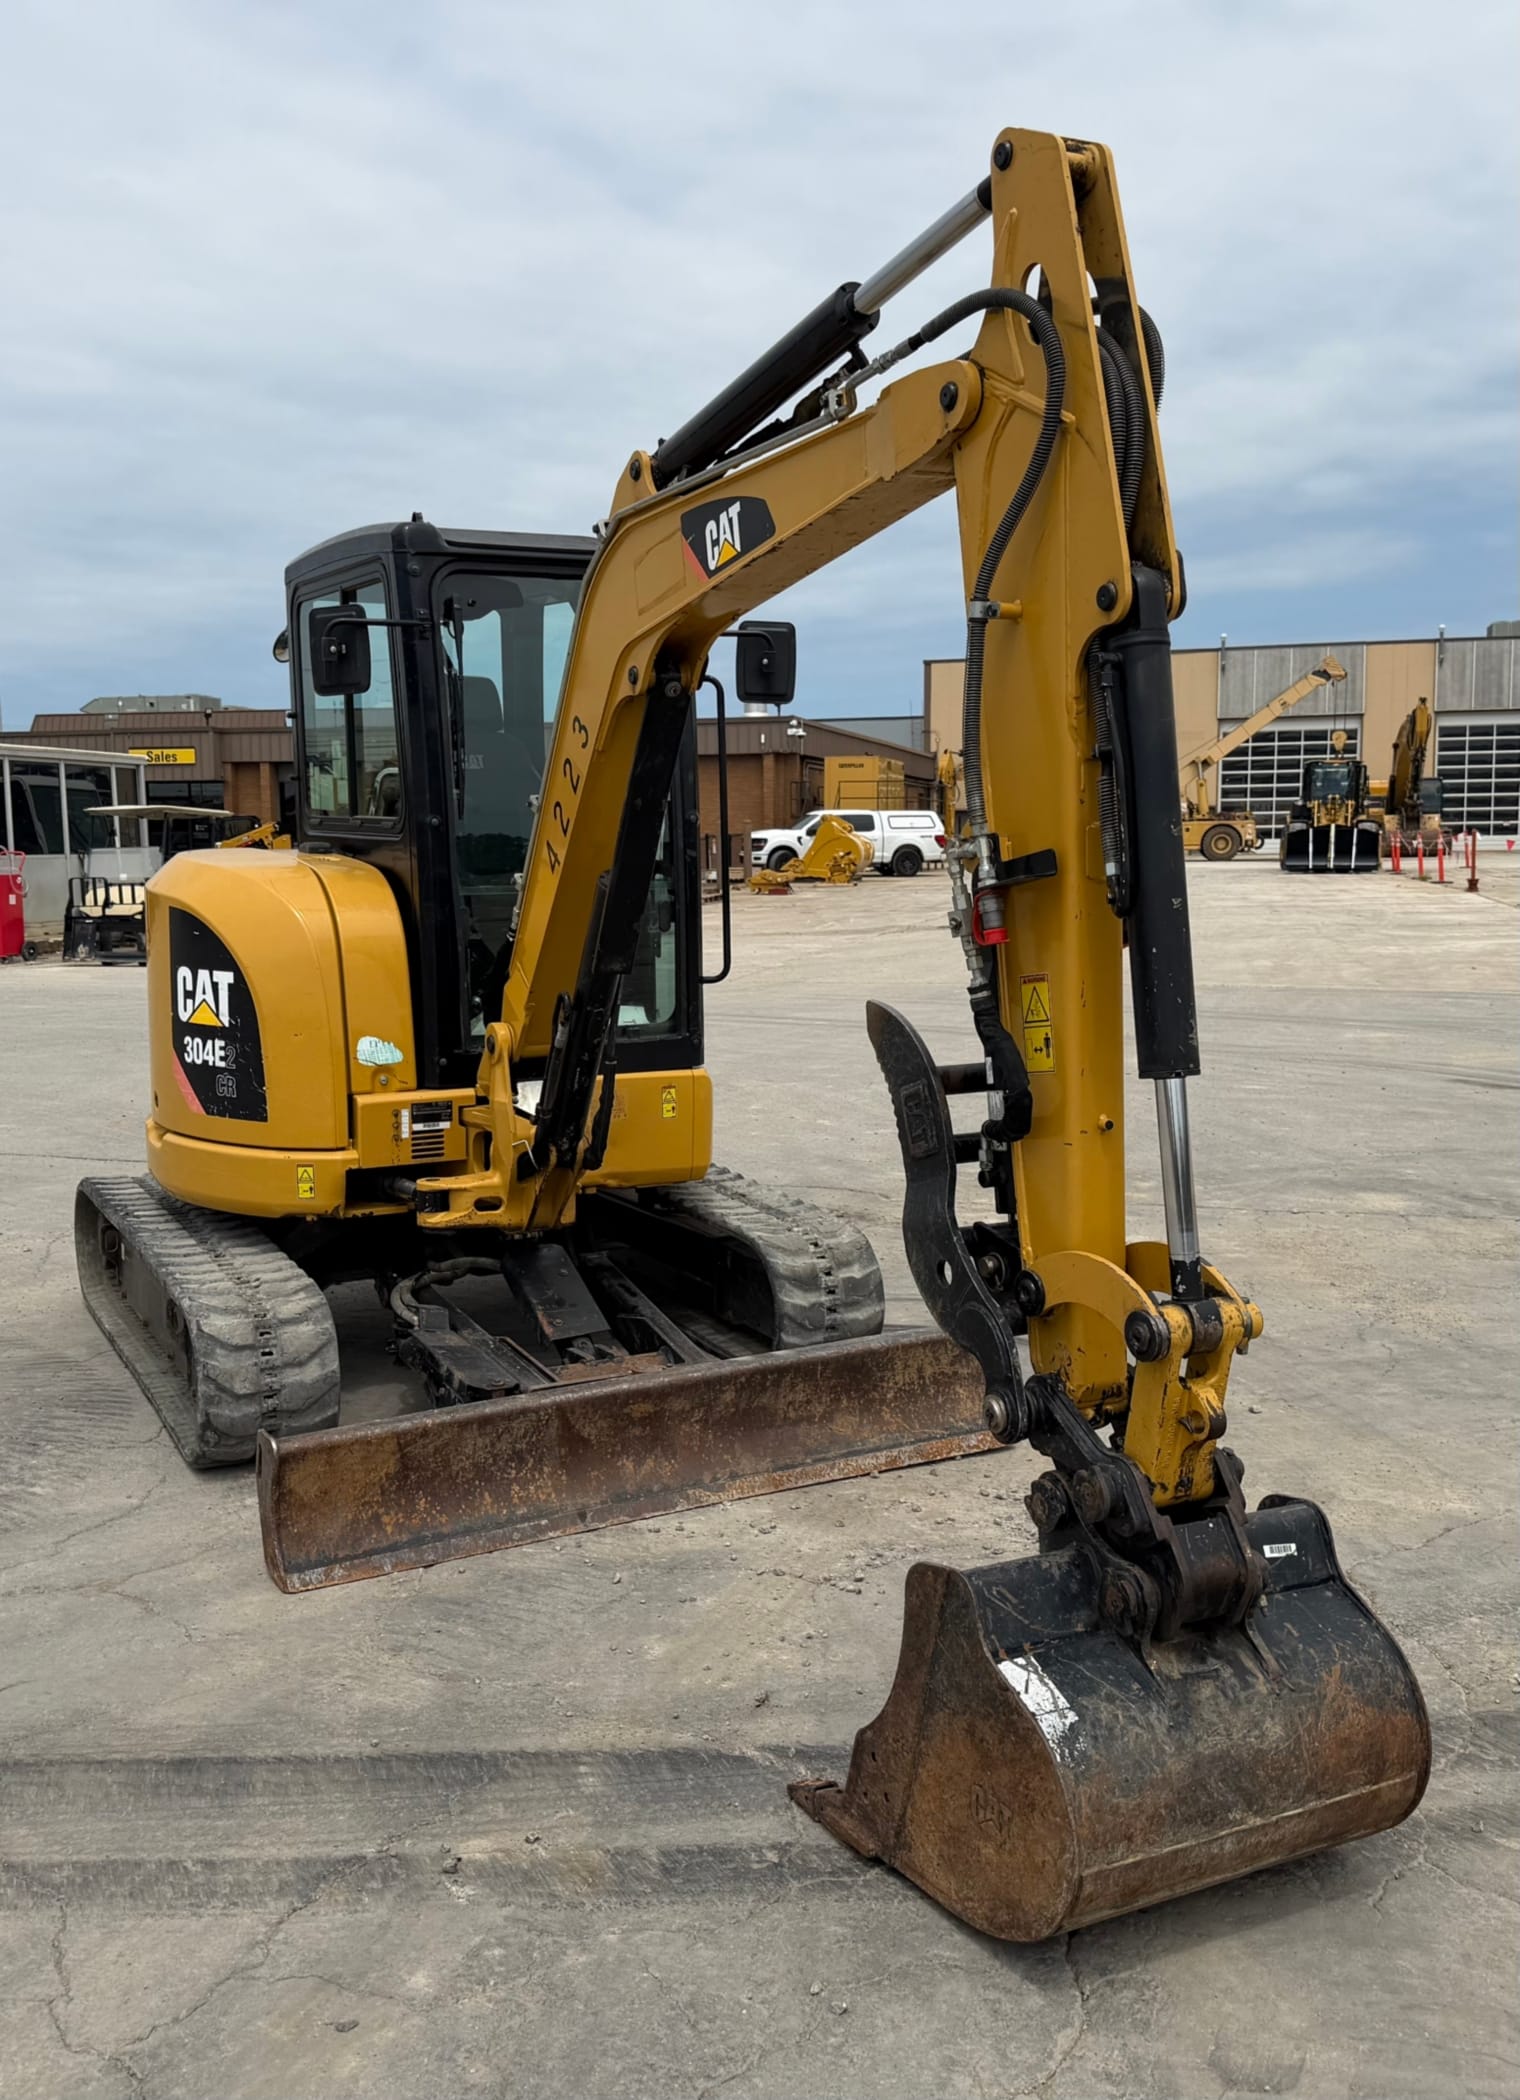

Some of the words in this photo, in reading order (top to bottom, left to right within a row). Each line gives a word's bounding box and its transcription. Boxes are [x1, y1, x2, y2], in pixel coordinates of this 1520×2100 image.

[705, 500, 742, 571] CAT
[146, 750, 178, 763] Sales
[176, 965, 235, 1028] CAT
[215, 1073, 237, 1098] CR
